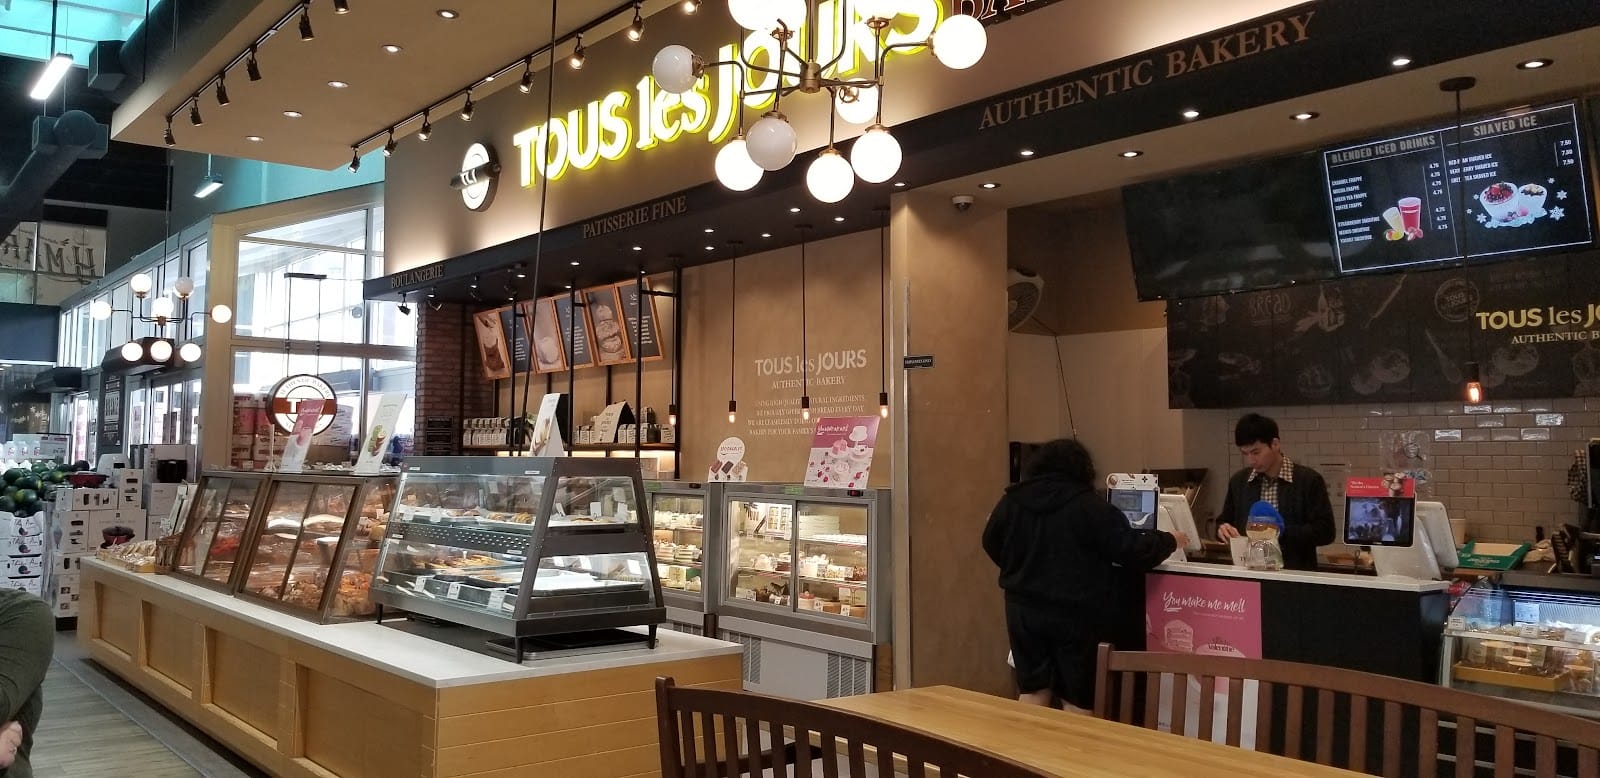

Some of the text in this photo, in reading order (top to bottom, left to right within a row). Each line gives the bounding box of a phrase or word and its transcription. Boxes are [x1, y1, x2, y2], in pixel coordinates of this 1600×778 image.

[978, 11, 1316, 131] AUTHENTIC BAKERY
[513, 91, 633, 189] TOUS
[636, 74, 711, 150] les
[1473, 115, 1538, 137] SHAVED ICE
[1331, 135, 1436, 164] BLENDED ICED DRINKS
[583, 195, 687, 239] PATISSERIE FINE
[391, 264, 443, 289] BOULANGERIE
[1475, 308, 1543, 330] TOUS
[1547, 306, 1582, 326] les
[1511, 331, 1587, 345] AUTHENTIC
[755, 356, 793, 377] TOUS
[815, 349, 867, 376] JOURS
[816, 376, 846, 386] BAKERY
[1182, 596, 1206, 608] make
[1208, 599, 1221, 610] me
